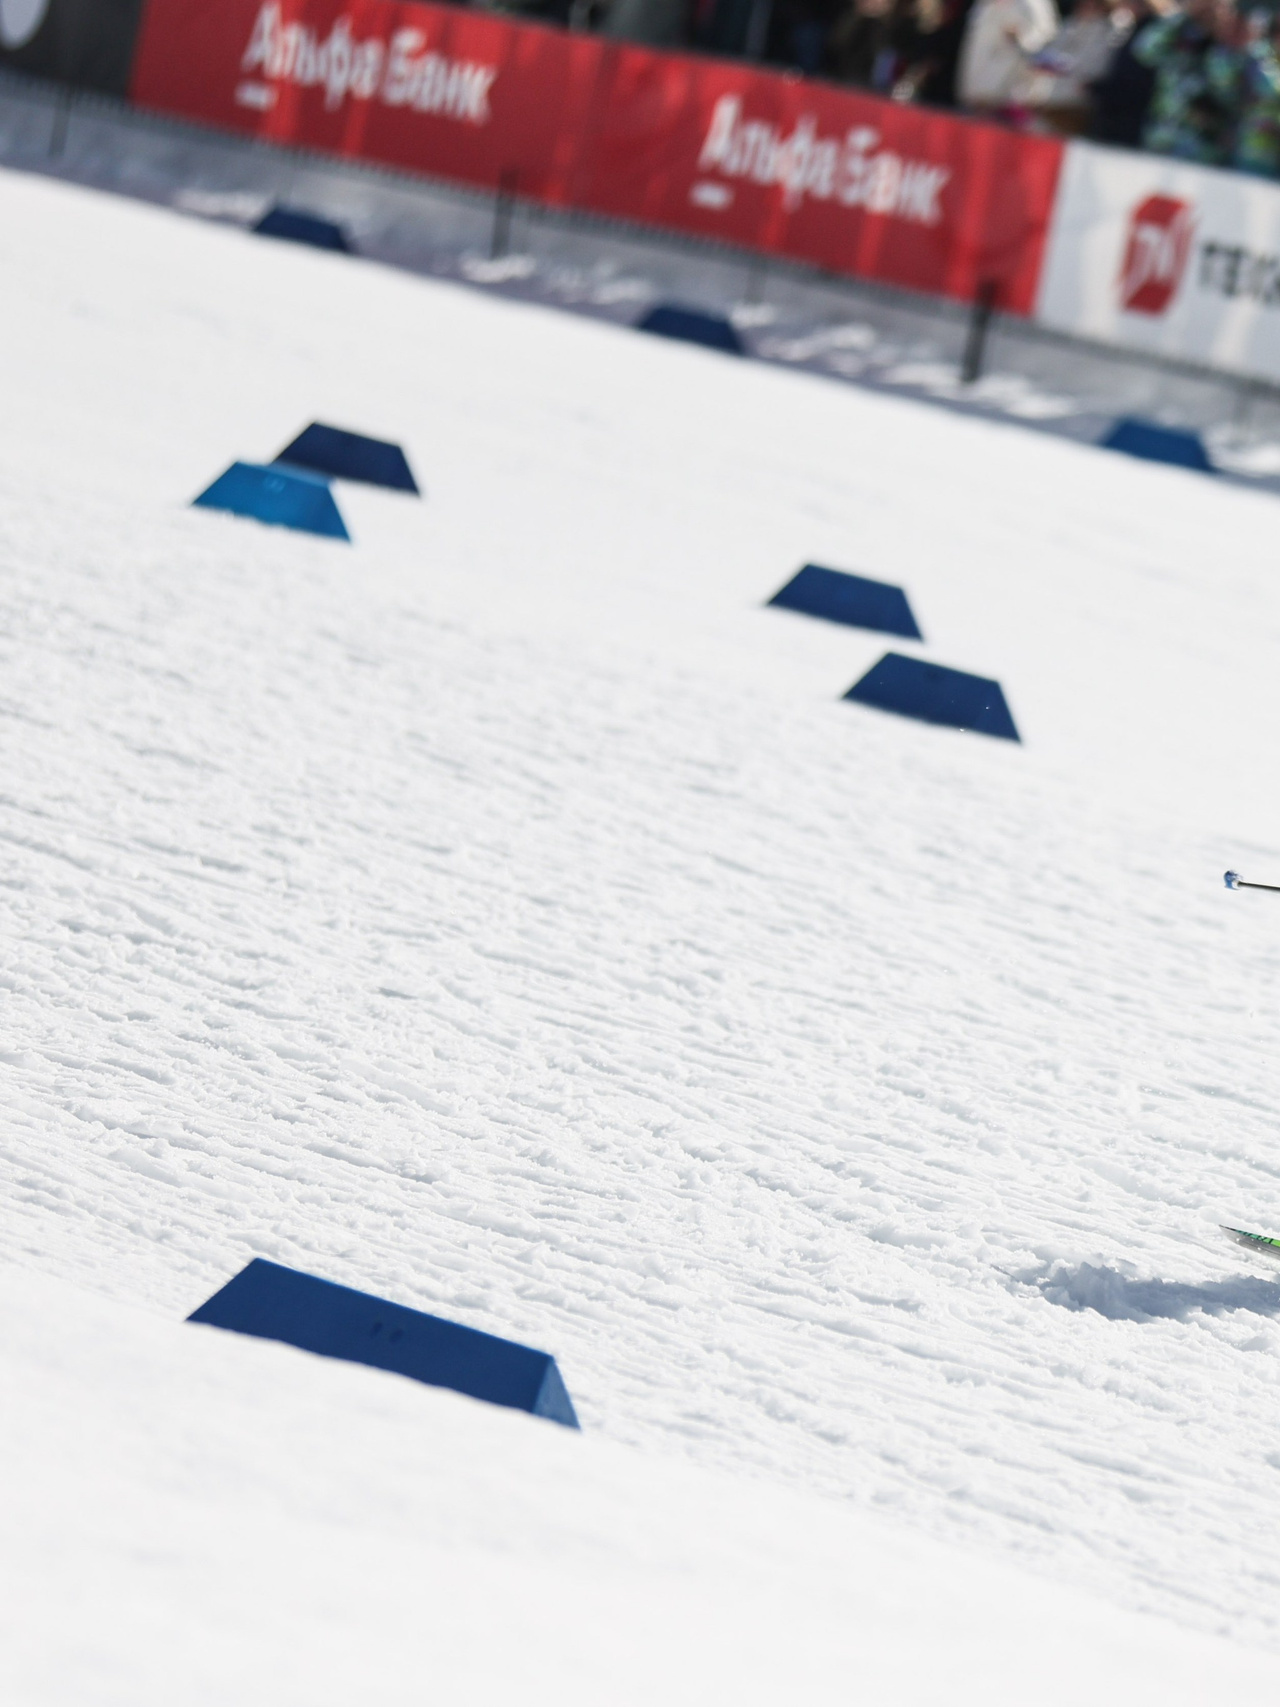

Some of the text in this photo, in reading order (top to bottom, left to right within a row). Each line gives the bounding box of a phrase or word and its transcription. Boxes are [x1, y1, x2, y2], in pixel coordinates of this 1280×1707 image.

[238, 1, 497, 127] Альфа Банк
[694, 95, 951, 227] Альфа Банк
